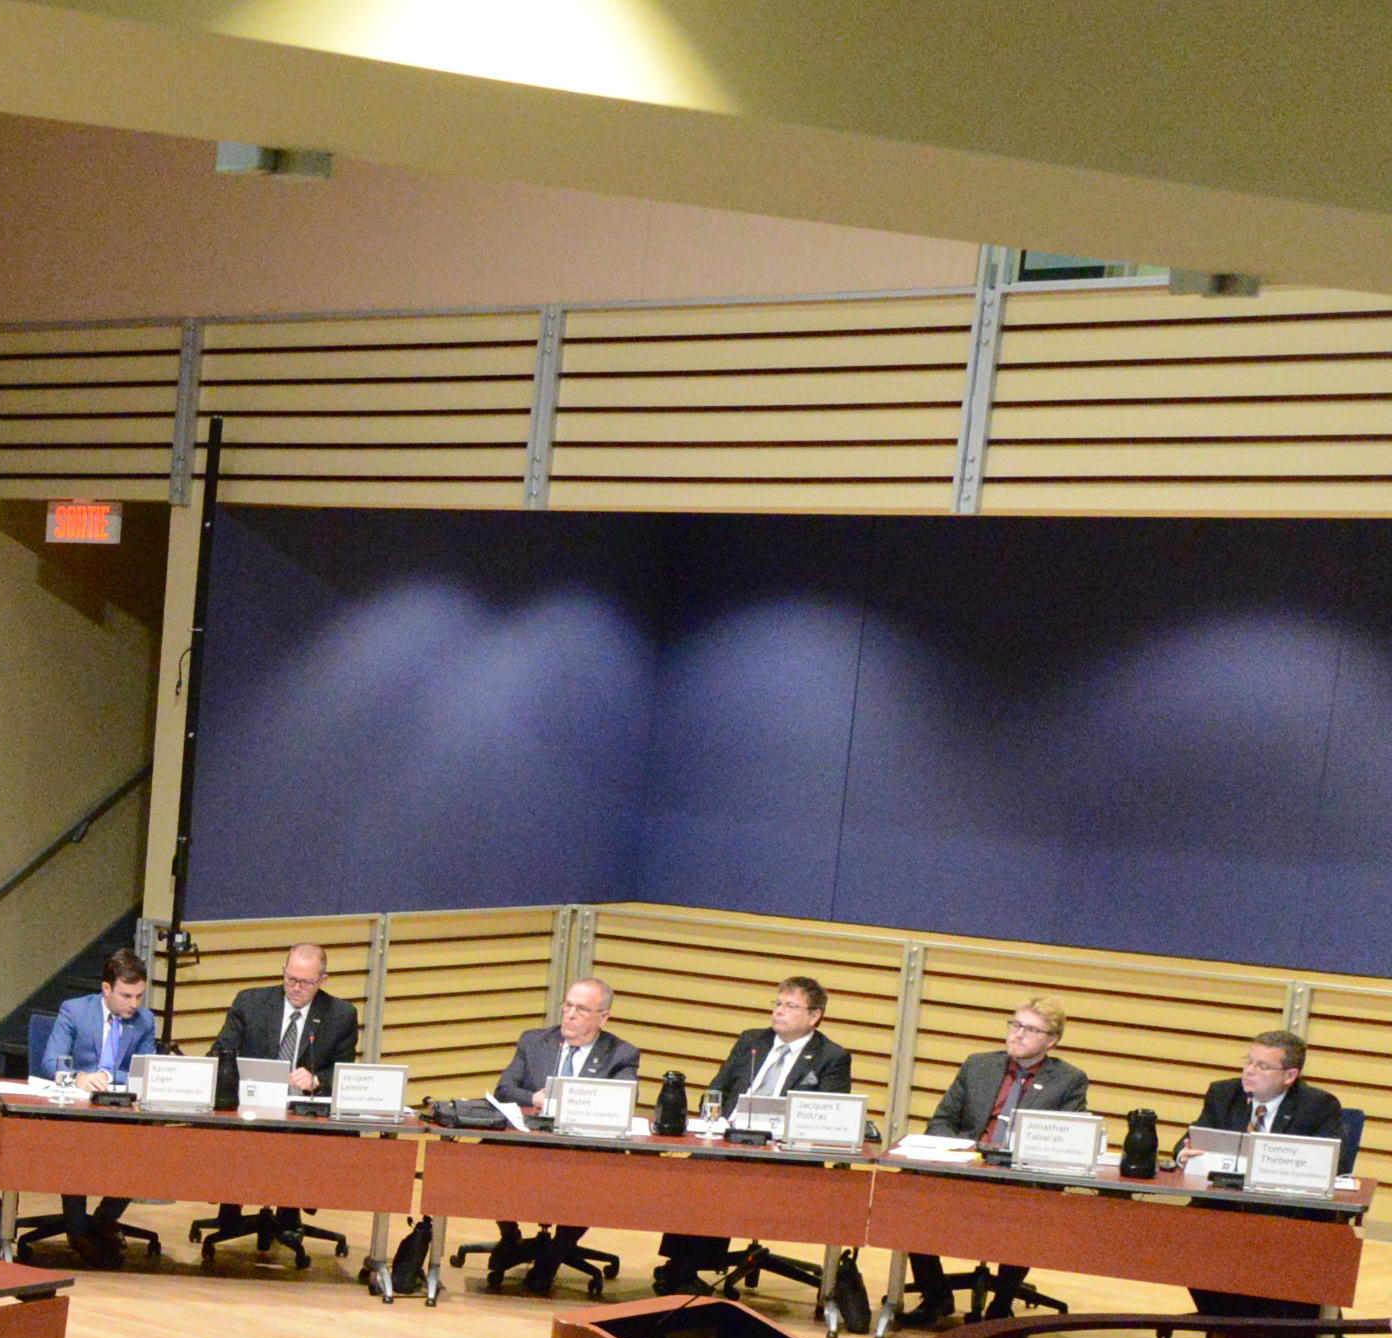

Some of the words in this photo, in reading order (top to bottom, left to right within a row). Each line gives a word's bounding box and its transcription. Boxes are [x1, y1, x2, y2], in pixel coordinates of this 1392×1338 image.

[54, 505, 110, 540] SORTIE
[568, 1088, 597, 1097] Robert
[798, 1101, 833, 1111] Jacques
[1026, 1122, 1070, 1133] Jonathan
[1263, 1143, 1298, 1155] Tommy
